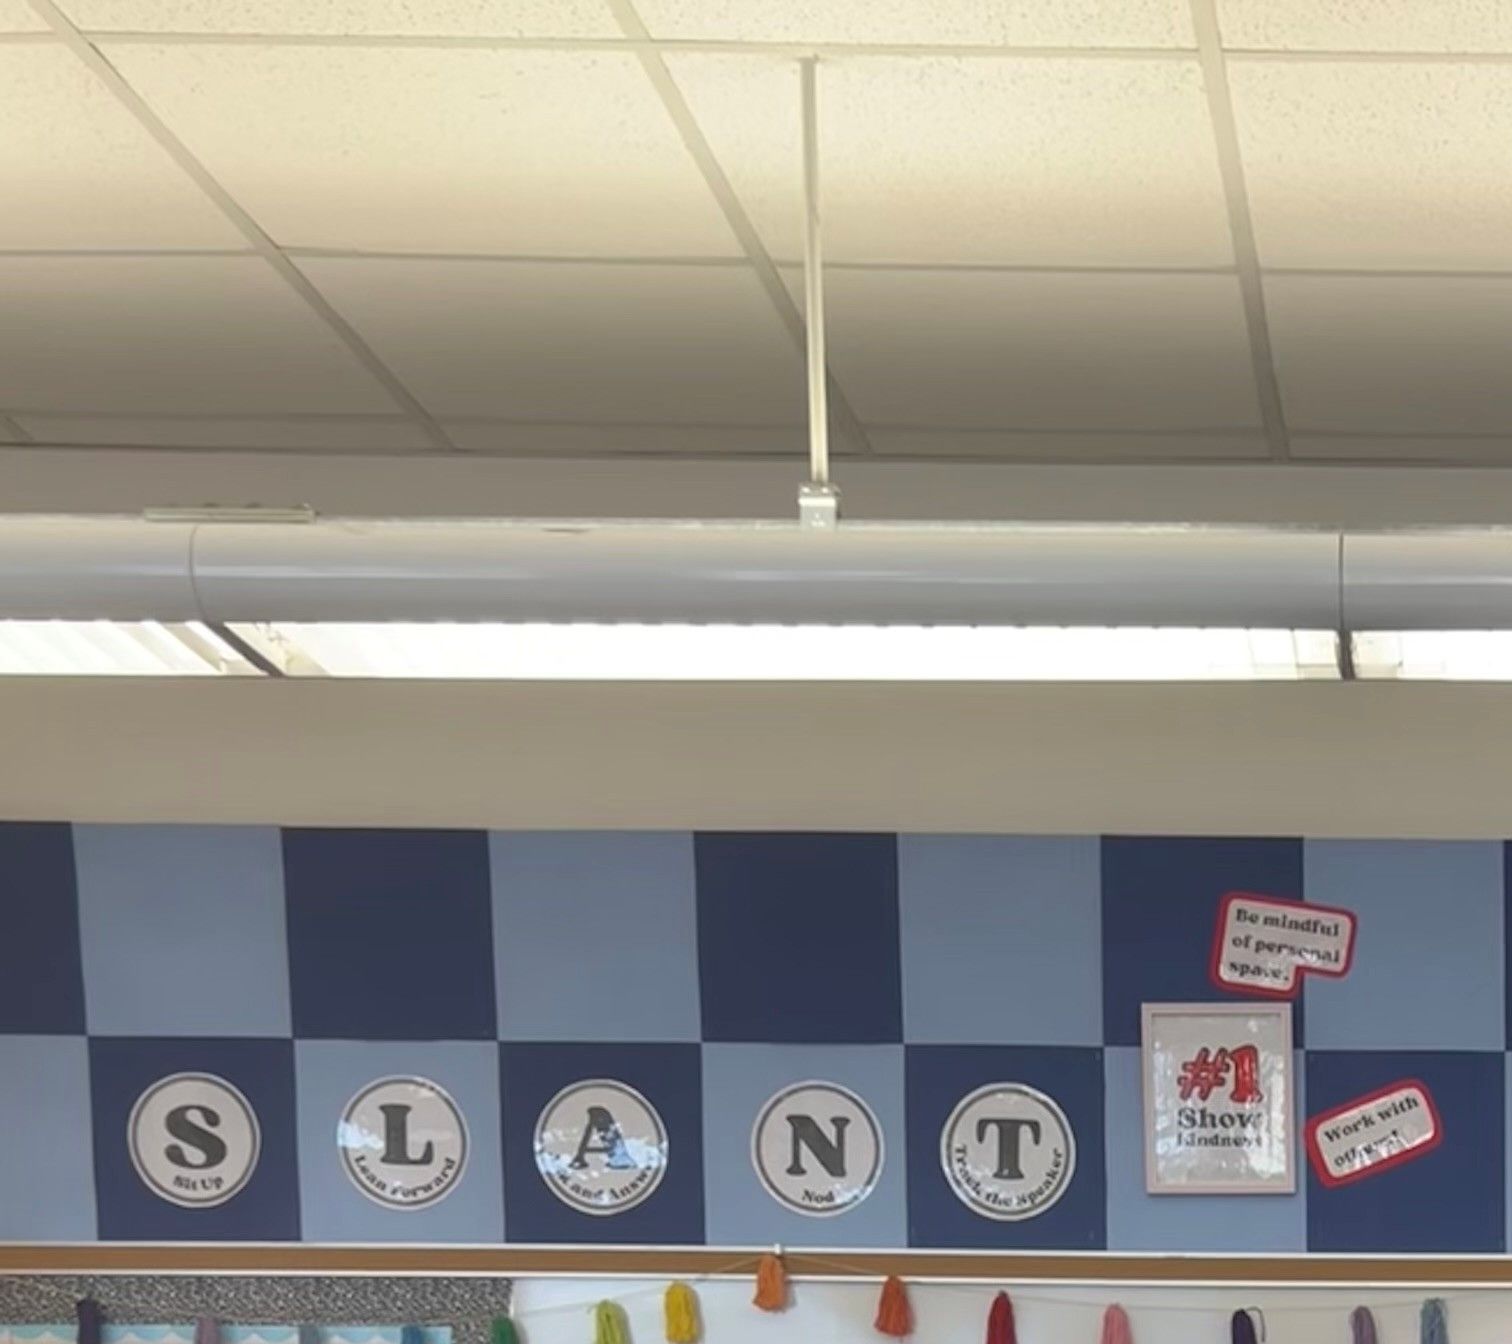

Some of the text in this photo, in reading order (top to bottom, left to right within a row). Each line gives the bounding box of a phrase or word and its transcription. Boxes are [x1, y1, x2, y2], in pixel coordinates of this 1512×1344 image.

[1235, 907, 1340, 937] Be mindful
[1232, 935, 1341, 963] of personal
[1177, 1044, 1264, 1104] #1
[1177, 1107, 1263, 1129] Show
[1324, 1097, 1419, 1142] Work with
[164, 1104, 1041, 1179] S L A N T
[201, 1175, 225, 1190] Up
[355, 1155, 456, 1198] Lean Forward
[802, 1188, 834, 1204] Nod
